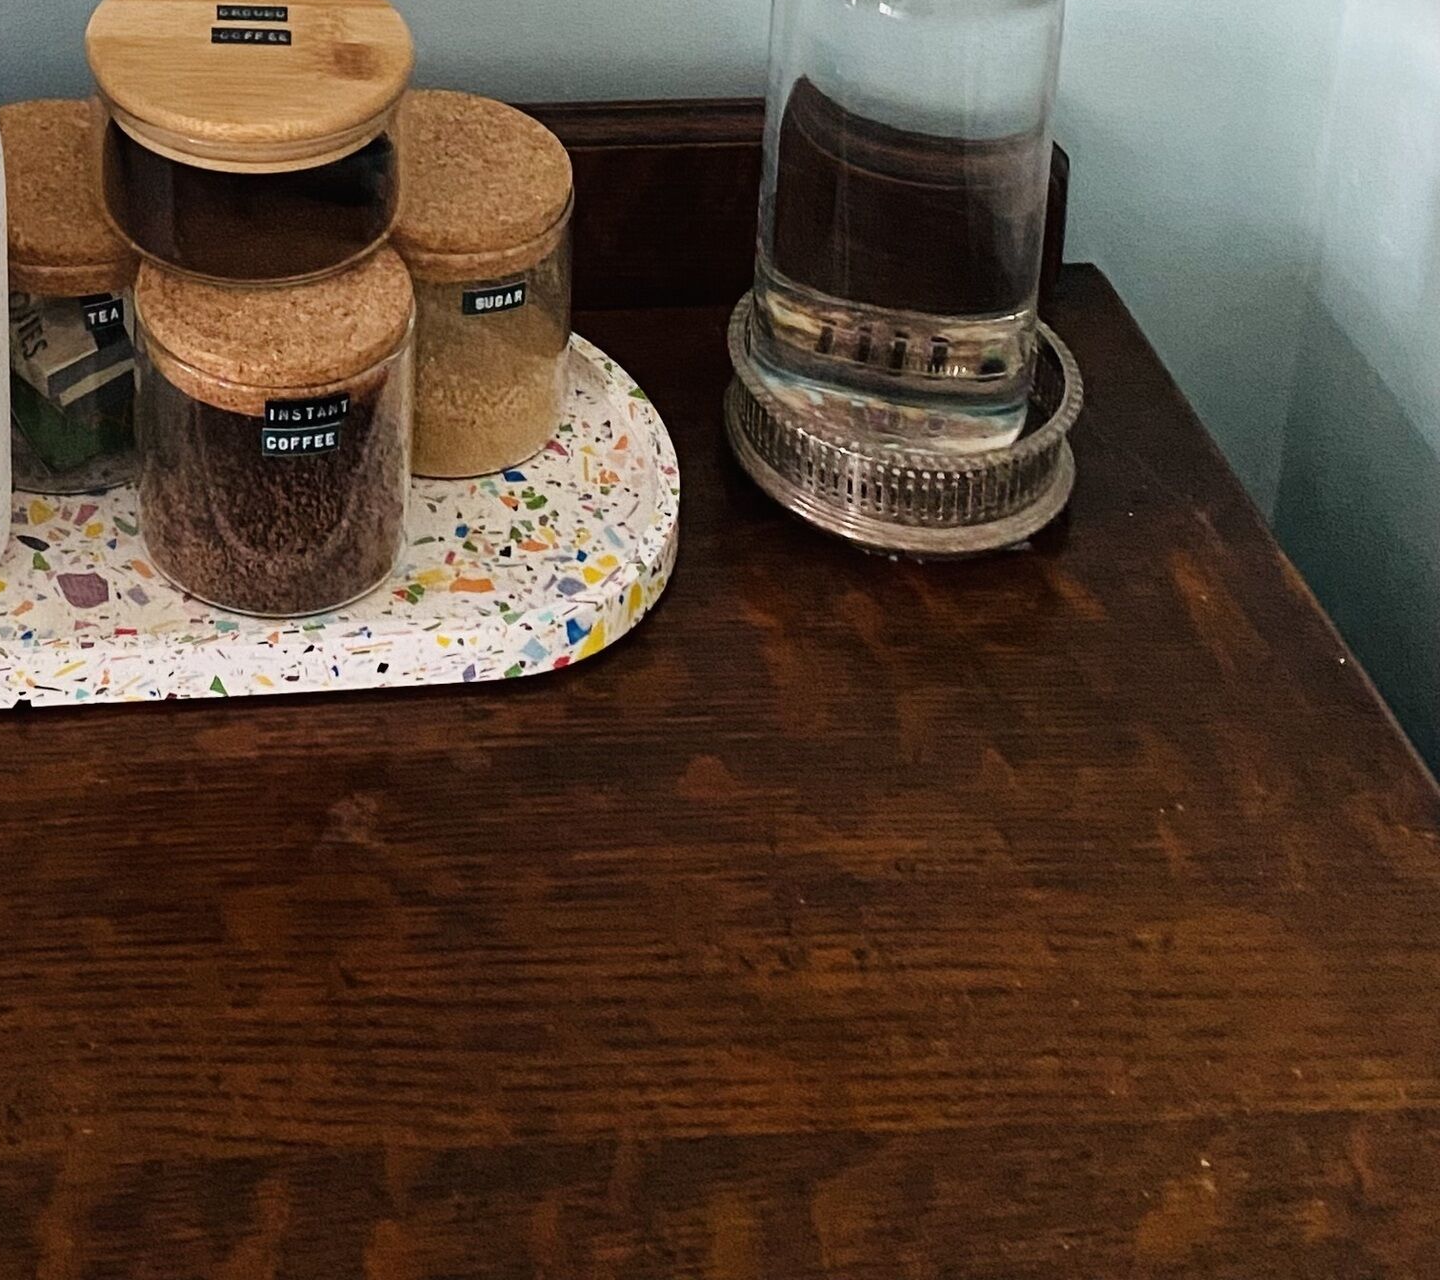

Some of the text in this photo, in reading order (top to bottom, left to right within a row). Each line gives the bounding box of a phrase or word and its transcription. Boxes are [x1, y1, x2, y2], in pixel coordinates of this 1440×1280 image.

[219, 30, 288, 42] COFFEE
[474, 289, 523, 310] SUGAR
[87, 307, 120, 325] TEA
[269, 398, 349, 421] INSTANT
[265, 431, 336, 451] COFFEE
